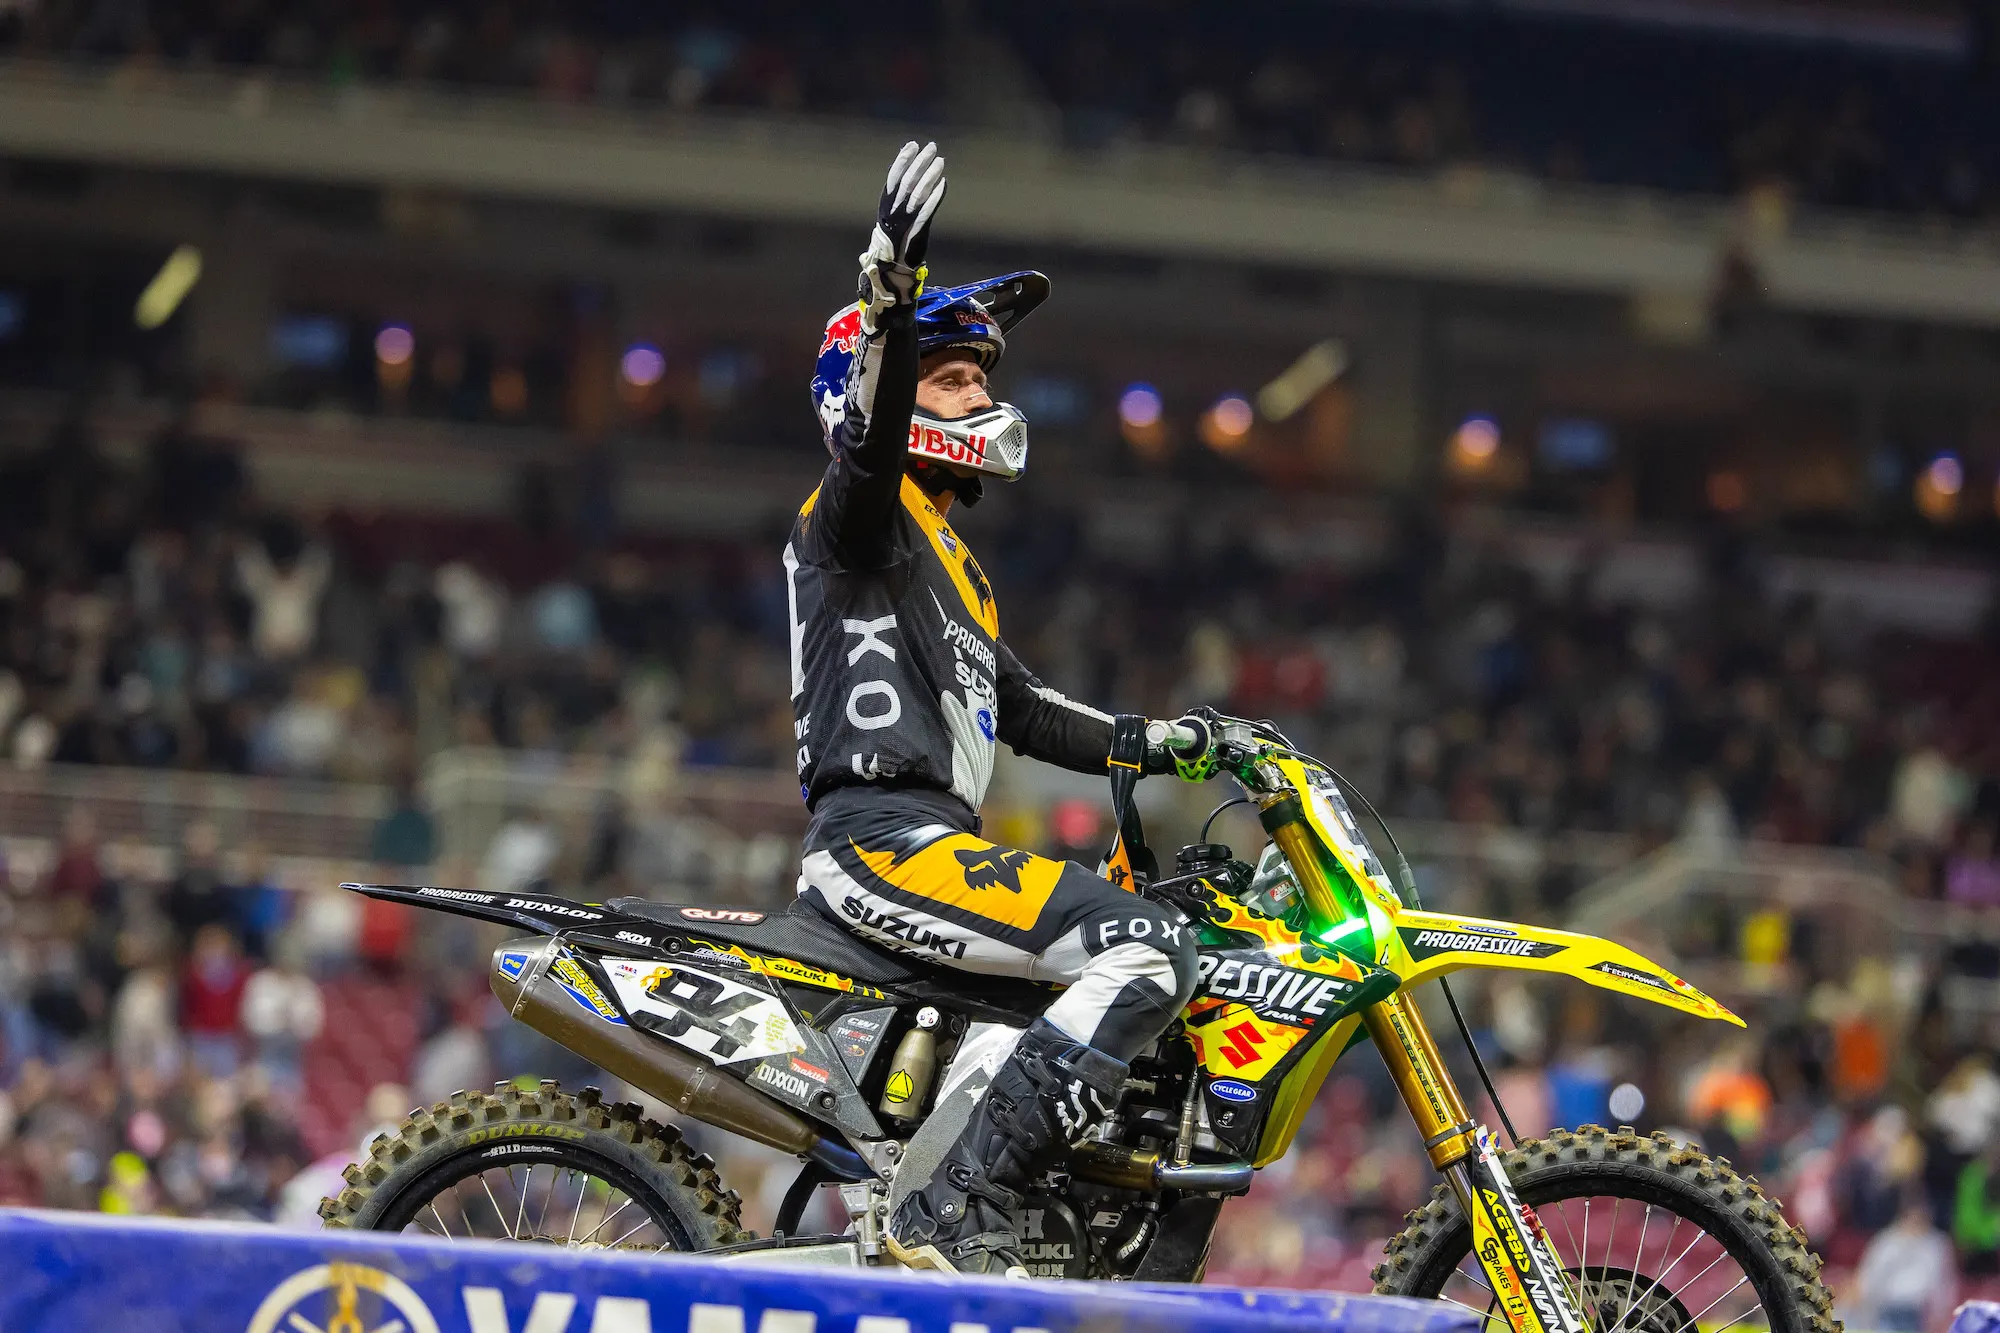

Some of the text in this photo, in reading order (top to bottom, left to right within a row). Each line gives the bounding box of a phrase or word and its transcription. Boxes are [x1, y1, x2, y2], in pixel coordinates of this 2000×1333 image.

[925, 428, 986, 466] Bull
[955, 661, 998, 717] SUZU
[416, 887, 496, 904] PROGRESSIVE
[504, 899, 604, 921] DUNLOP
[681, 908, 763, 922] GUTS
[841, 895, 967, 960] SUZUKI
[1099, 918, 1181, 948] FOX
[1414, 931, 1535, 956] PROGRESSIVE
[557, 961, 616, 1018] CIRCUIT
[774, 964, 827, 983] SUZUKI
[1198, 955, 1346, 1016] RESSIVE
[630, 967, 766, 1059] 94
[1263, 1010, 1315, 1026] RM-Z
[757, 1063, 809, 1098] DIXXON
[791, 1062, 827, 1084] makita
[1390, 1013, 1446, 1123] SUSPENSION
[469, 1123, 585, 1144] DUNLOP
[1483, 1188, 1531, 1273] ACERBIS
